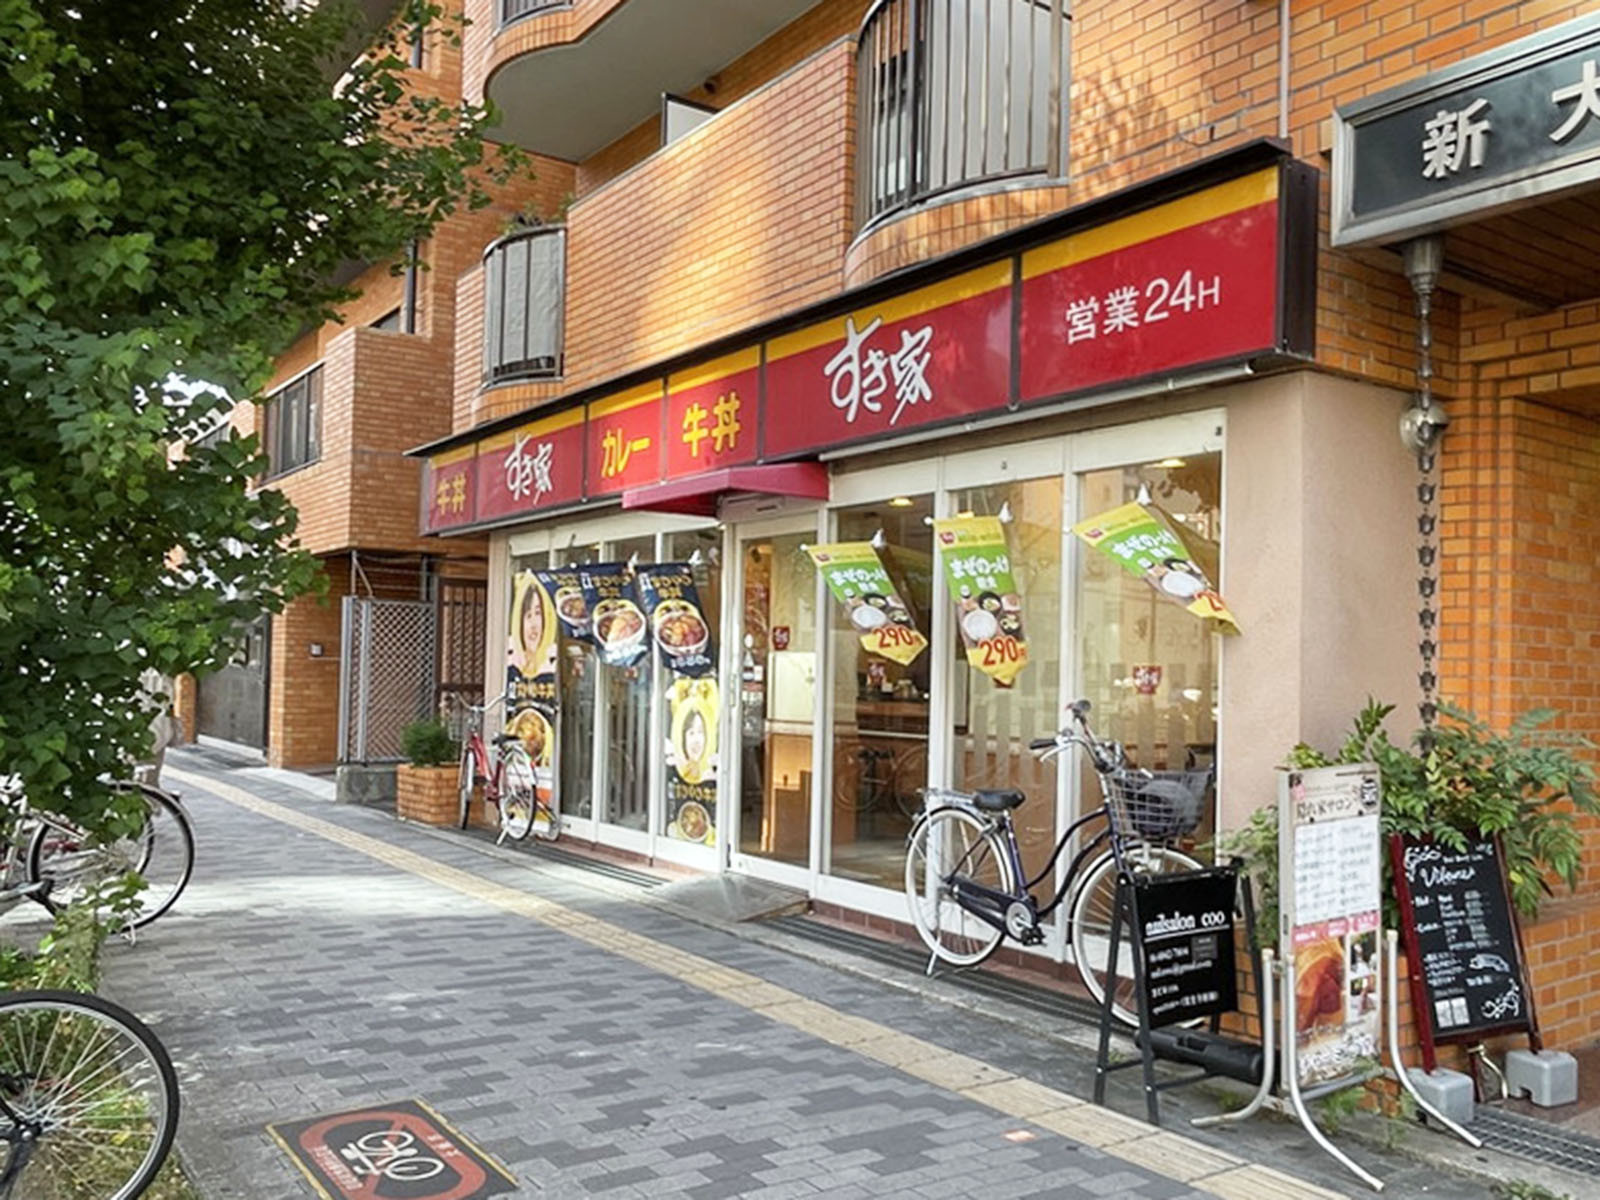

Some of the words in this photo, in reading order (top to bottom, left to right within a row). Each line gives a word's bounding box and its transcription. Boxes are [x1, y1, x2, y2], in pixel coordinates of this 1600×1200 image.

[437, 470, 466, 515] 牛丼
[504, 432, 552, 505] すき家
[602, 429, 650, 477] カレー
[682, 392, 741, 457] 牛丼
[824, 317, 932, 425] すき家
